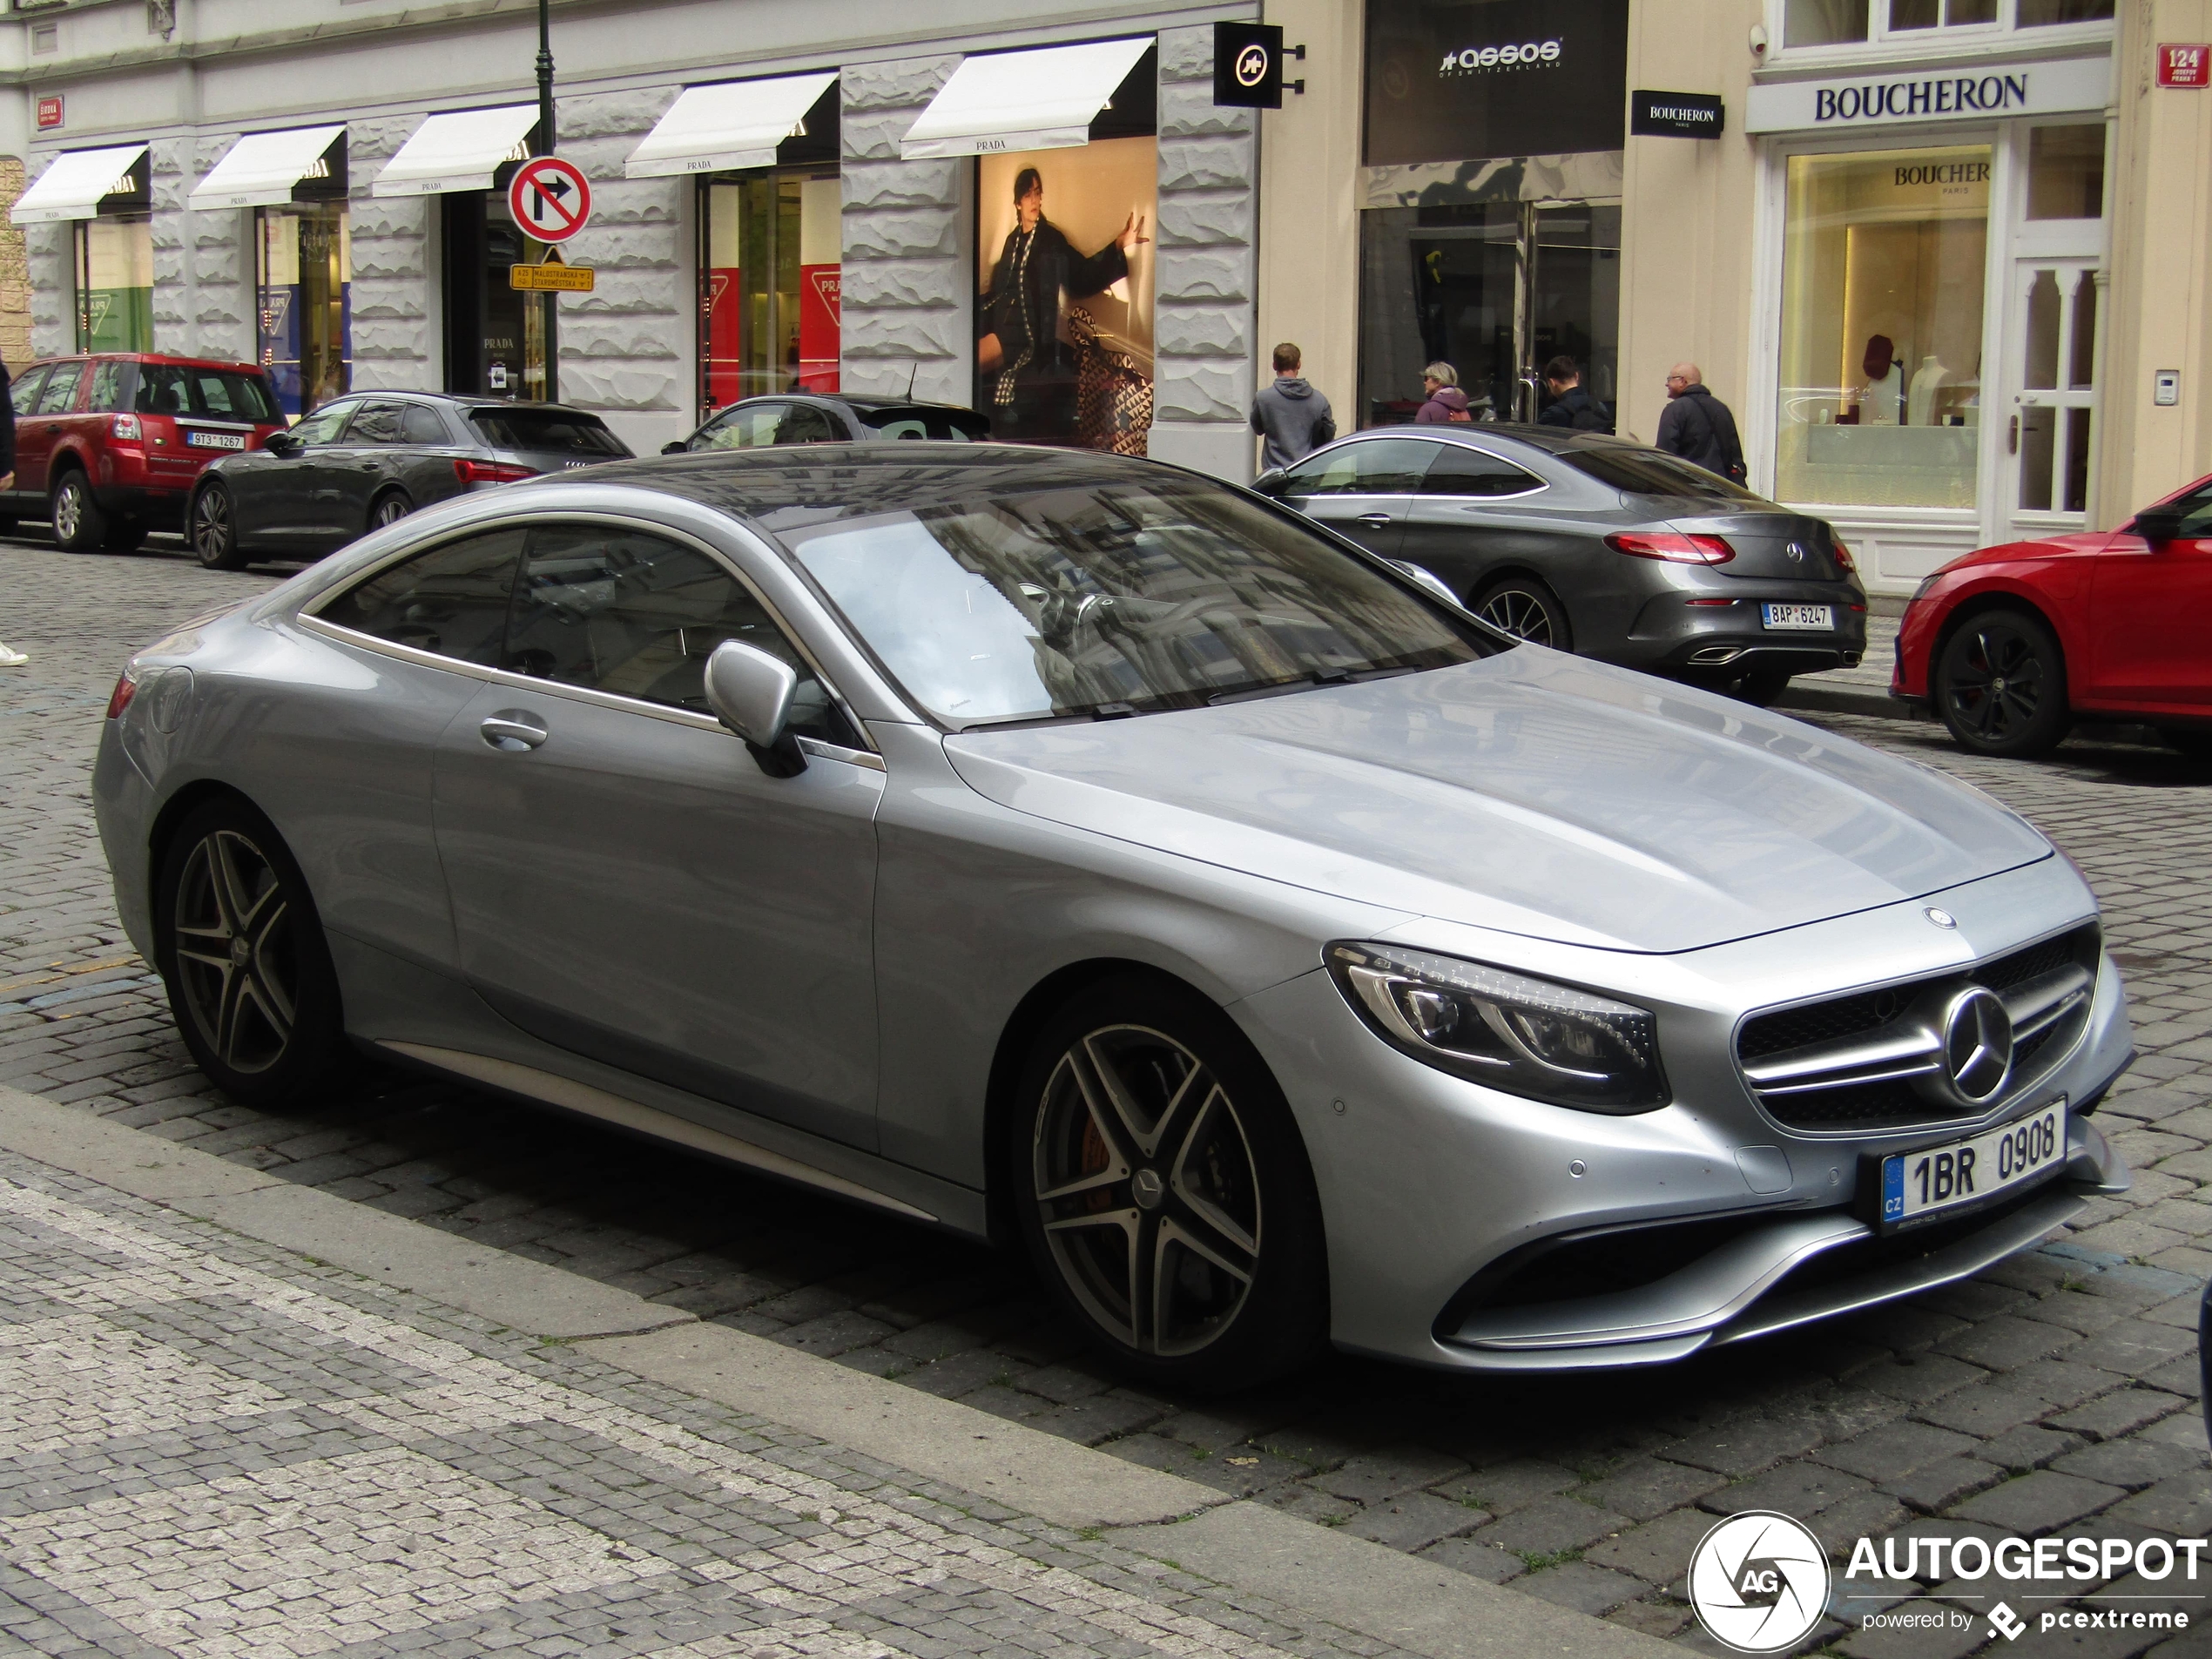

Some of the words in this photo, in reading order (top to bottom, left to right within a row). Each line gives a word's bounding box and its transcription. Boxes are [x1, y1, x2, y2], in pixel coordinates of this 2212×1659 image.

[2168, 50, 2198, 68] 124
[1458, 62, 1561, 77] SWITZERLAND
[1815, 74, 2028, 122] BOUCHERON
[1650, 106, 1714, 122] BOUCHERON
[976, 140, 1006, 151] PRADA
[687, 161, 711, 170] PRADA
[1894, 163, 1991, 186] BOUCHER
[484, 338, 514, 349] PRADA
[194, 434, 212, 445] 9T3
[219, 436, 240, 447] 1267
[1772, 606, 1792, 623] 8AP
[1800, 607, 1825, 624] 6247
[1914, 1146, 1976, 1204] 1BR
[1999, 1112, 2055, 1179] 0908
[1885, 1197, 1901, 1213] CZ
